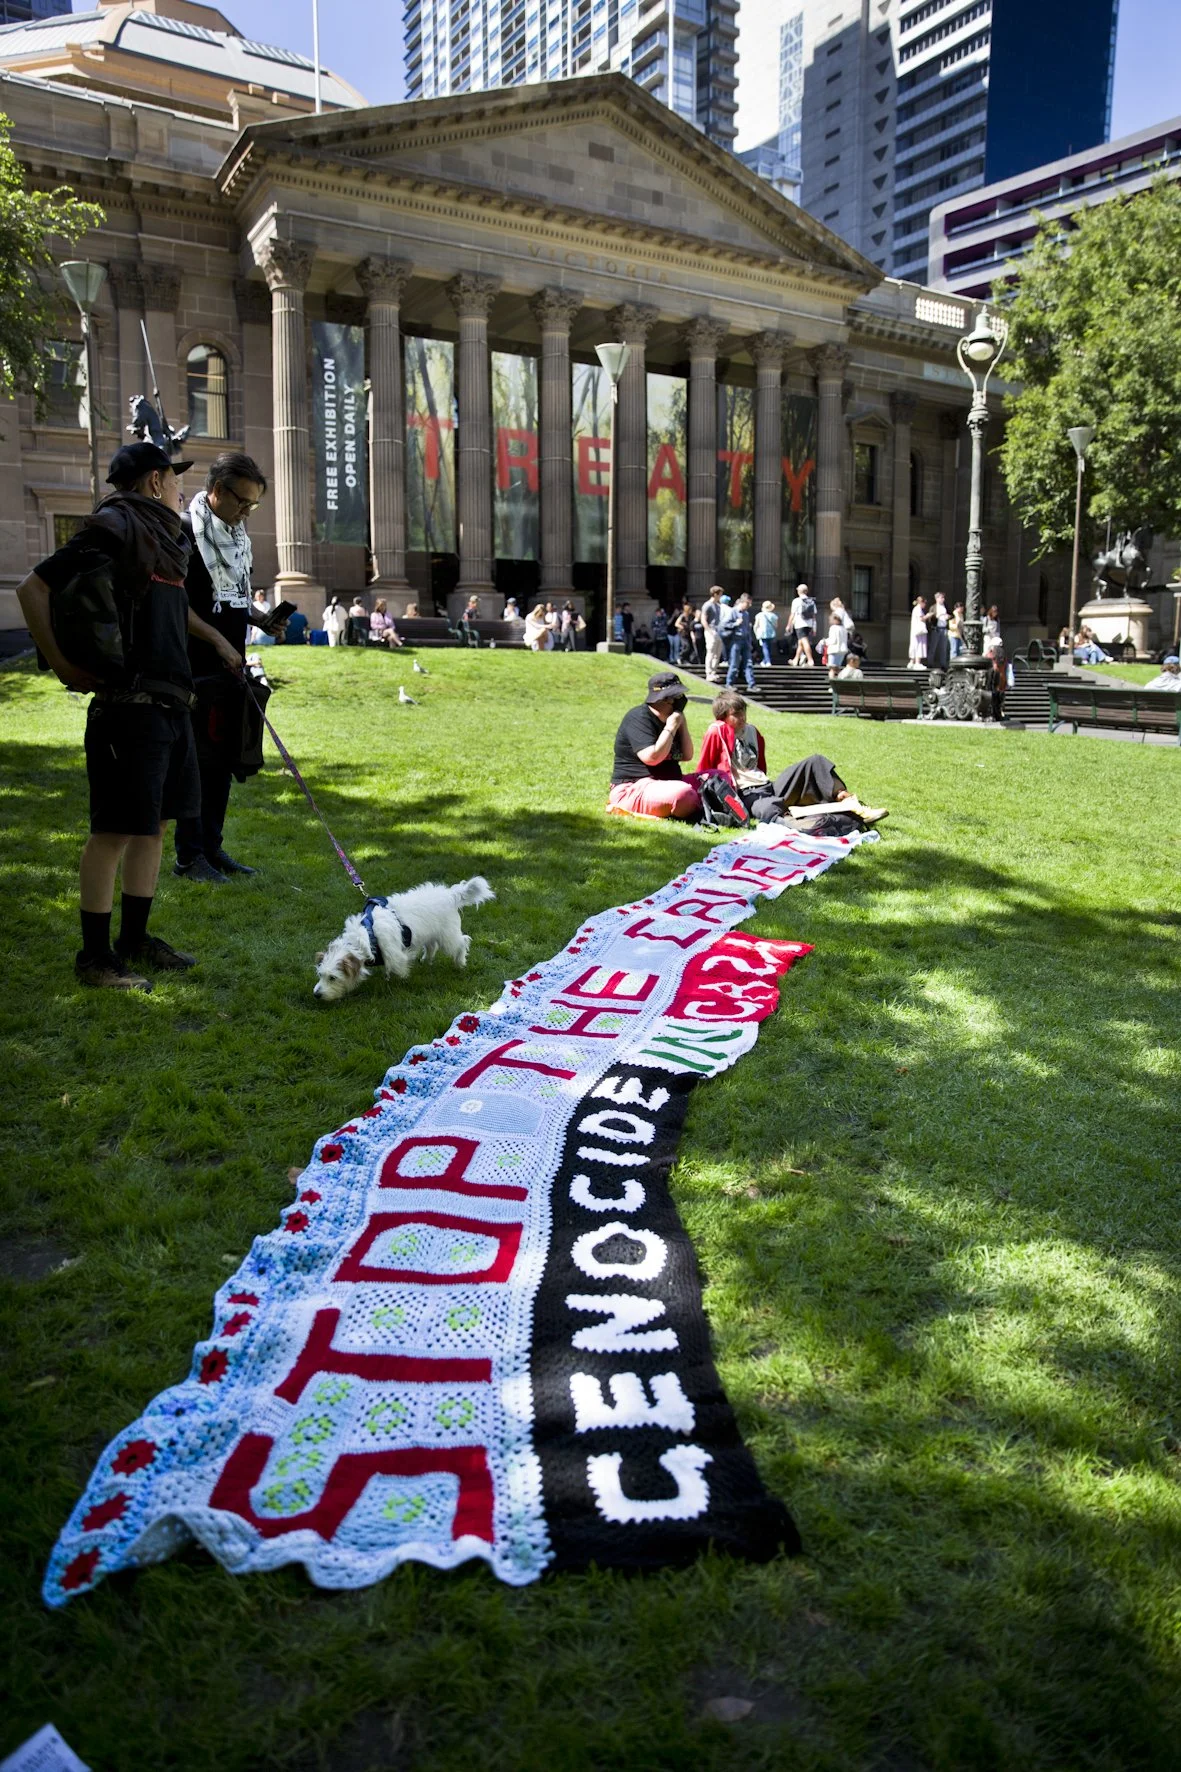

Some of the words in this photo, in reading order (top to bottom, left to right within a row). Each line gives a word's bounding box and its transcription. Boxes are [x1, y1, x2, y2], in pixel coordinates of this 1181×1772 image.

[527, 241, 669, 284] VICTORIA
[323, 358, 338, 461] EXHIBITION
[344, 383, 356, 435] DAILY
[344, 440, 357, 488] OPEN
[406, 411, 816, 512] TREATY
[326, 466, 338, 510] FREE
[639, 1023, 743, 1073] IN
[208, 1136, 529, 1544] STOP
[453, 965, 660, 1089] THE
[565, 1076, 714, 1524] GENOCIDE
